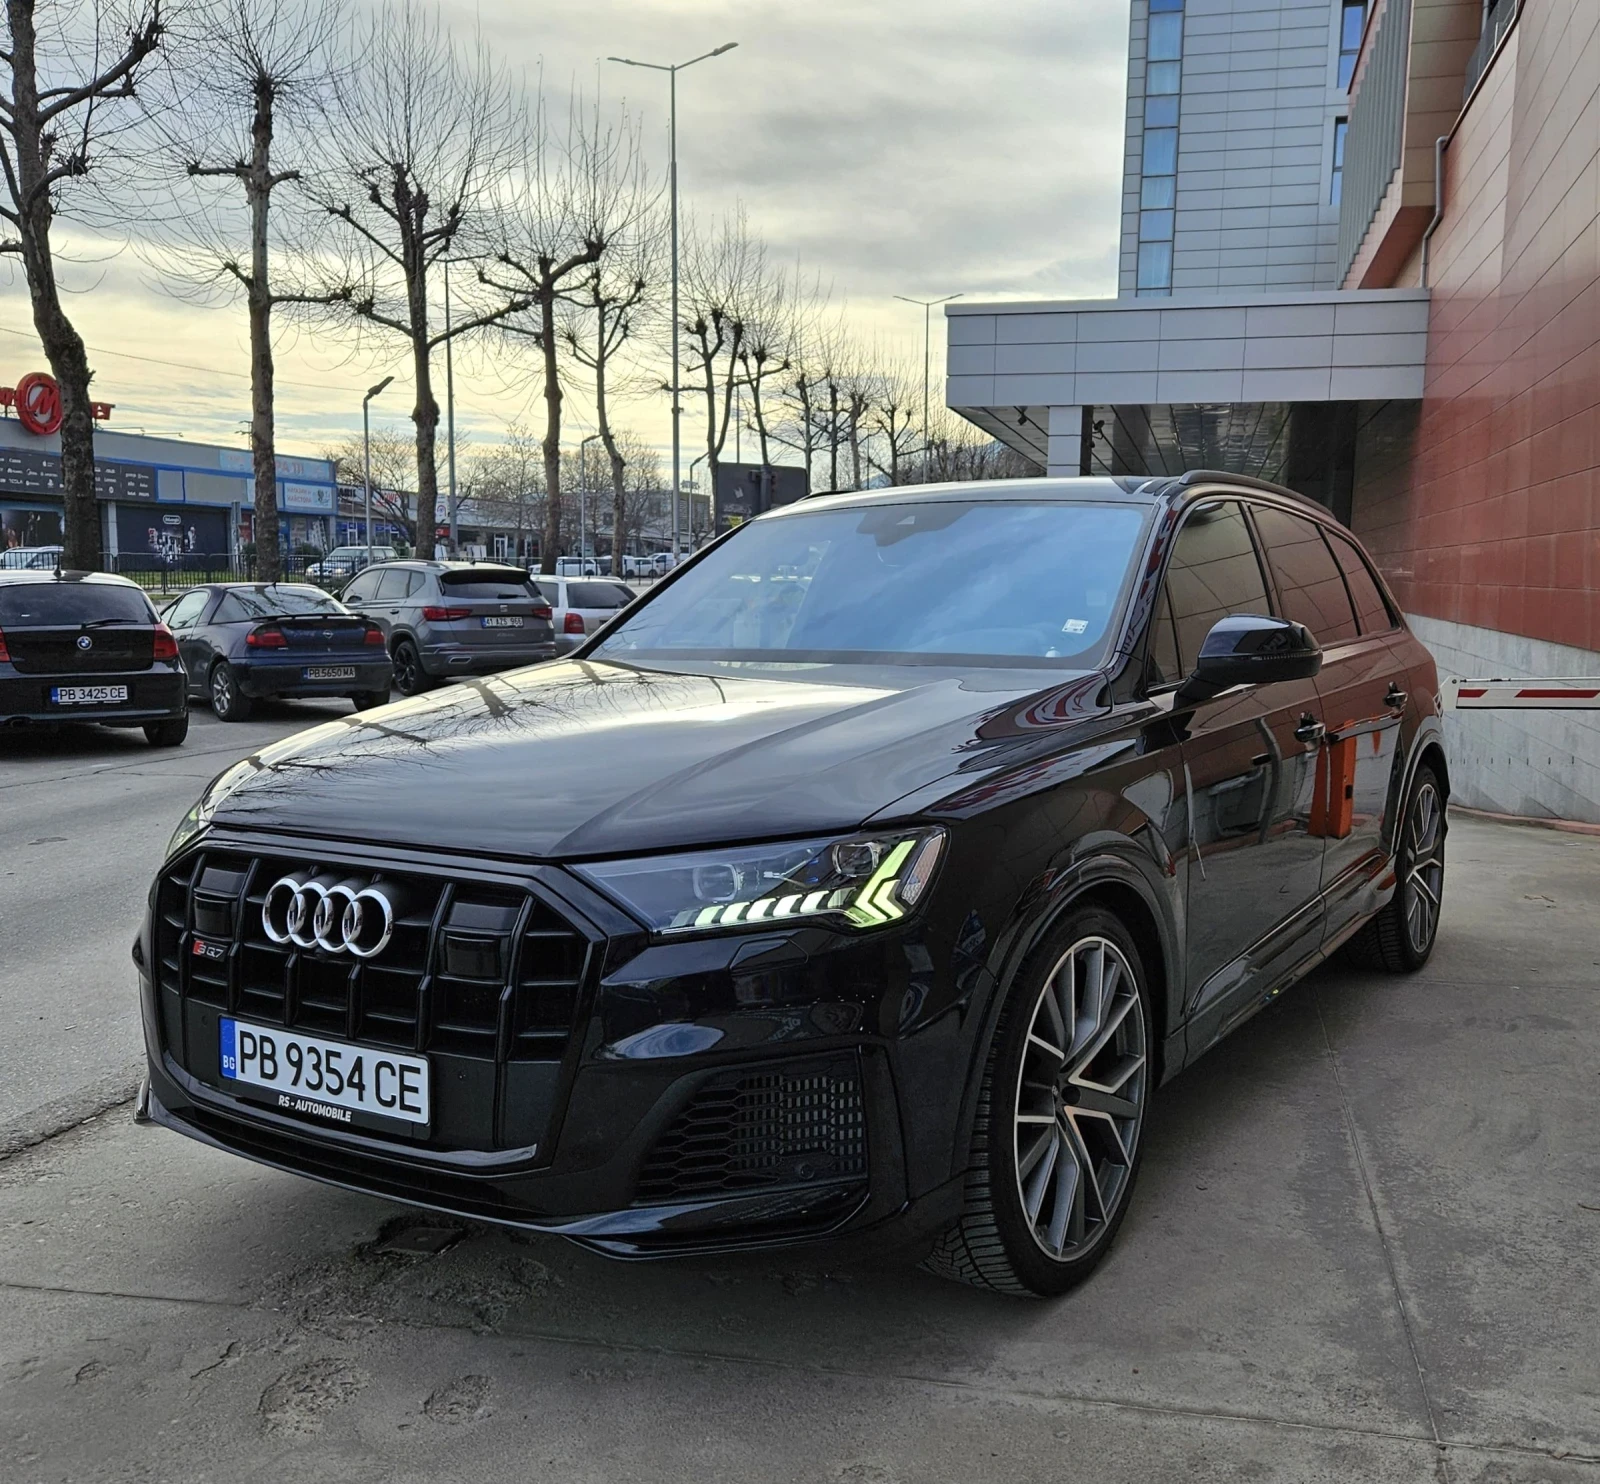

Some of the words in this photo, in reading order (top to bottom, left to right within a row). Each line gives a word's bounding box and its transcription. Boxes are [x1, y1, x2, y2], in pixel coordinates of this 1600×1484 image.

[60, 689, 76, 700] PB
[78, 687, 108, 700] 3425
[110, 687, 126, 699] CE
[193, 940, 224, 958] SQ7
[222, 1054, 236, 1071] BG
[239, 1029, 279, 1081] PB
[285, 1041, 366, 1102] 9354
[374, 1060, 422, 1115] CE
[278, 1094, 290, 1107] RS
[294, 1099, 352, 1122] AUTOMOBILE
